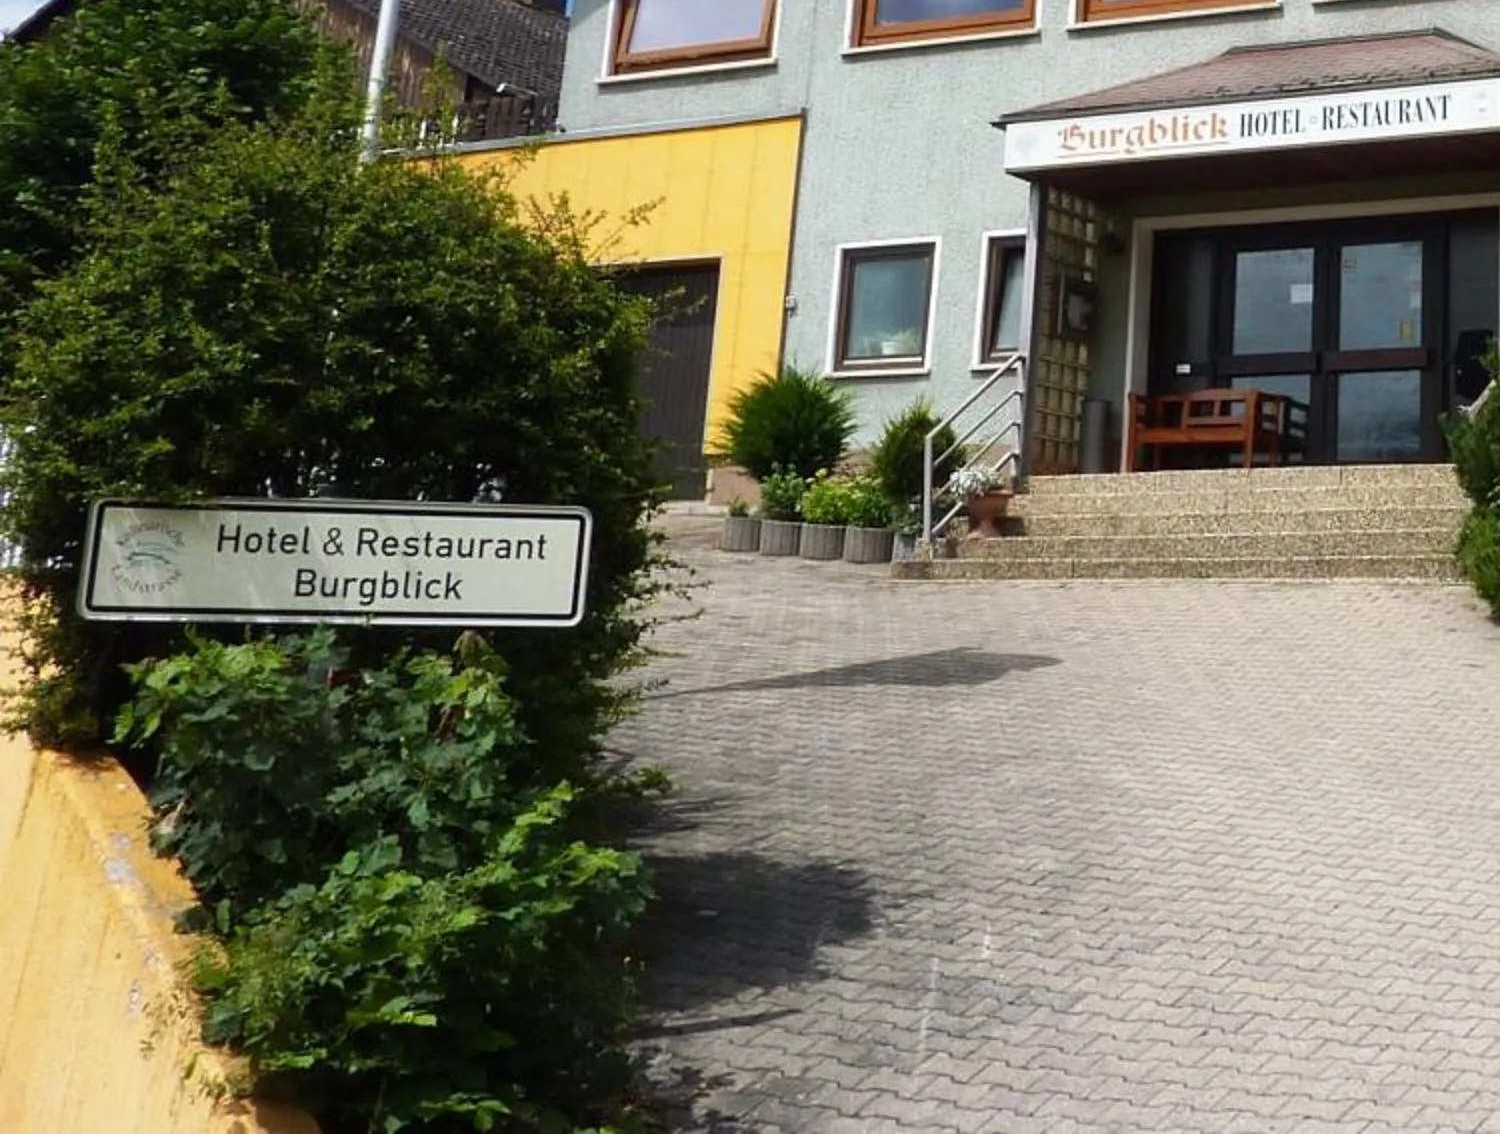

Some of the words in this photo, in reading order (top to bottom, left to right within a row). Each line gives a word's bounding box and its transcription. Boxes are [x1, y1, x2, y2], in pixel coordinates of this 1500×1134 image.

[1057, 112, 1228, 154] Burgblick
[1239, 108, 1306, 138] HOTEL
[1321, 93, 1453, 131] RESTAURANT
[216, 523, 310, 554] Hotel
[322, 527, 345, 556] &
[356, 527, 547, 560] Restaurant
[294, 568, 463, 606] Burgblick
